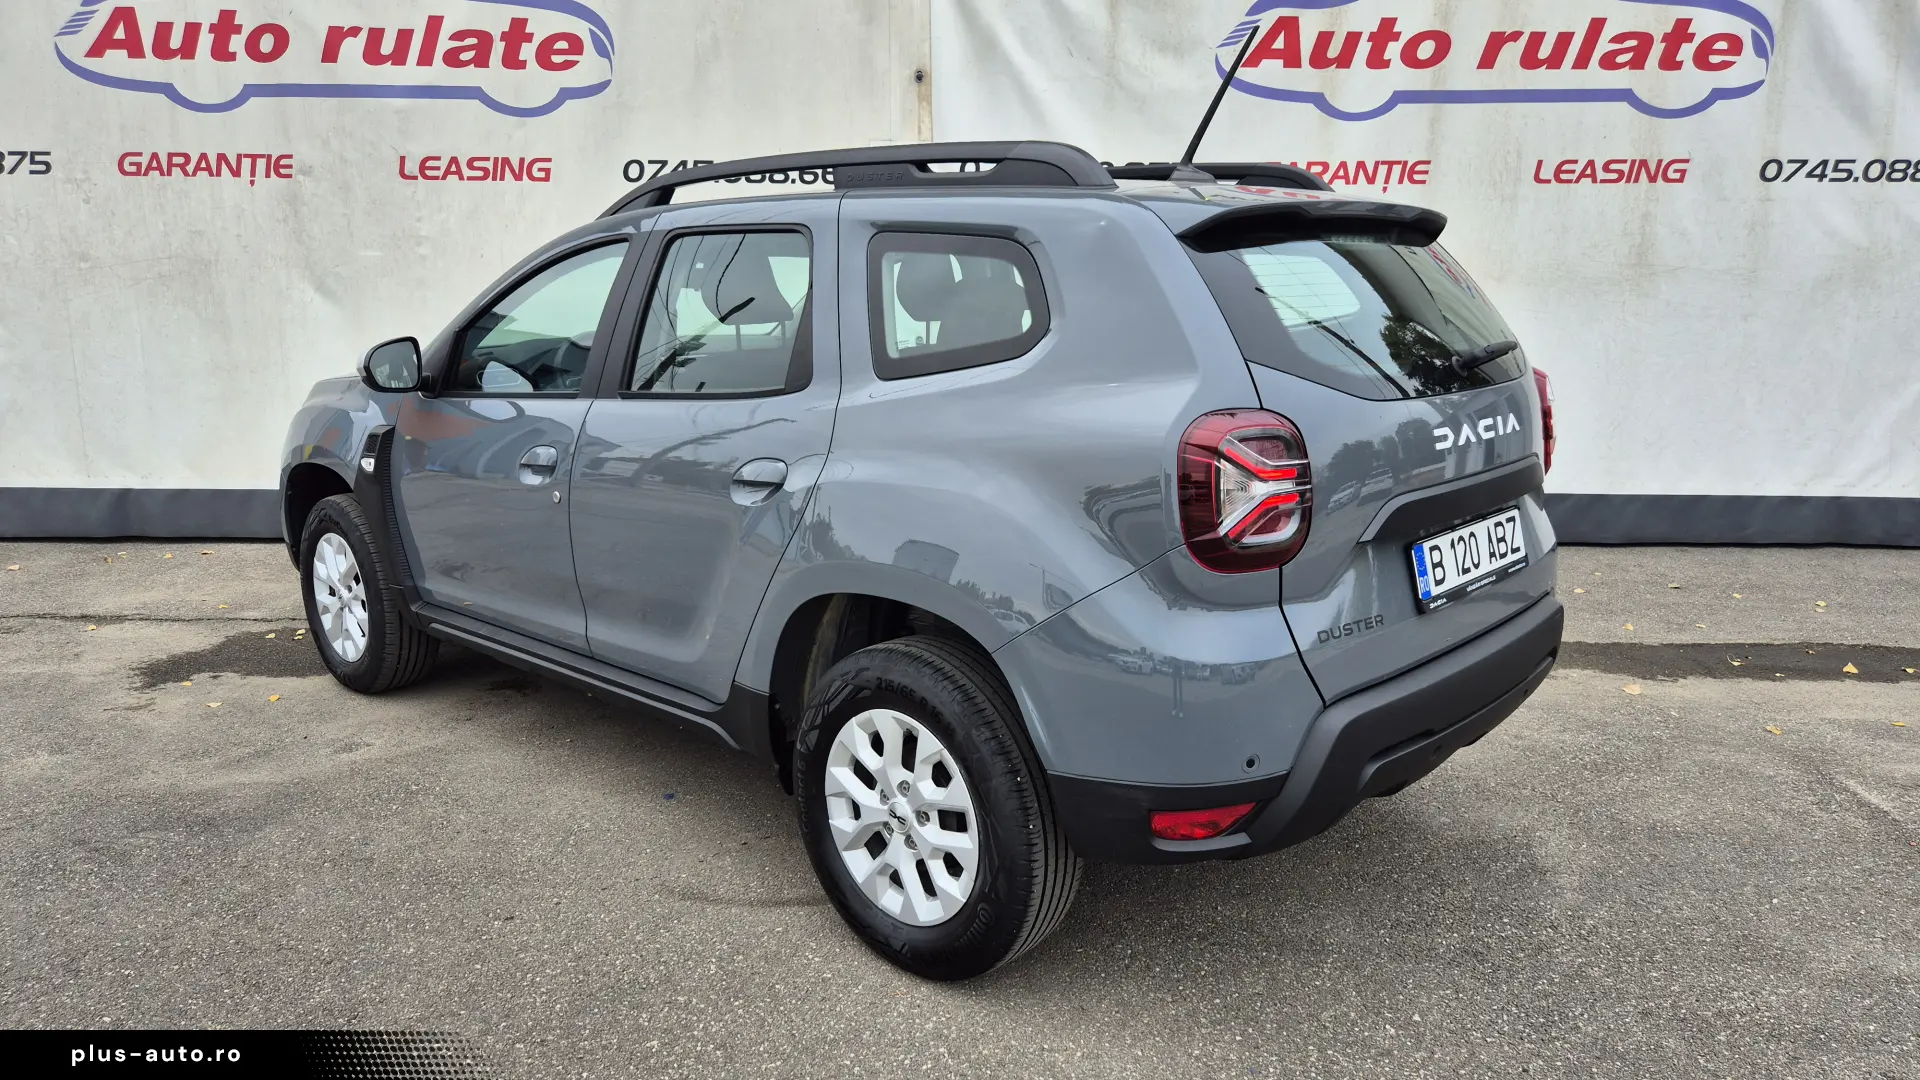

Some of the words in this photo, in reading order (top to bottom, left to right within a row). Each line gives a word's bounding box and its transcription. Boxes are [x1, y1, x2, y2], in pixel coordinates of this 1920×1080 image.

[84, 6, 291, 64] Auto
[320, 15, 585, 72] rulate
[1241, 15, 1453, 71] Auto
[1476, 17, 1745, 72] rulate
[117, 151, 294, 187] GARANȚIE
[399, 155, 553, 183] LEASING
[847, 171, 905, 182] DUSTER
[1264, 159, 1432, 195] RANȚIE
[1533, 158, 1691, 185] LEASING
[1432, 412, 1521, 450] DACIA
[1428, 544, 1446, 588] B
[1450, 531, 1481, 577] 120
[1487, 515, 1521, 565] ABZ
[1419, 576, 1431, 594] RO
[1316, 613, 1385, 644] DUSTER
